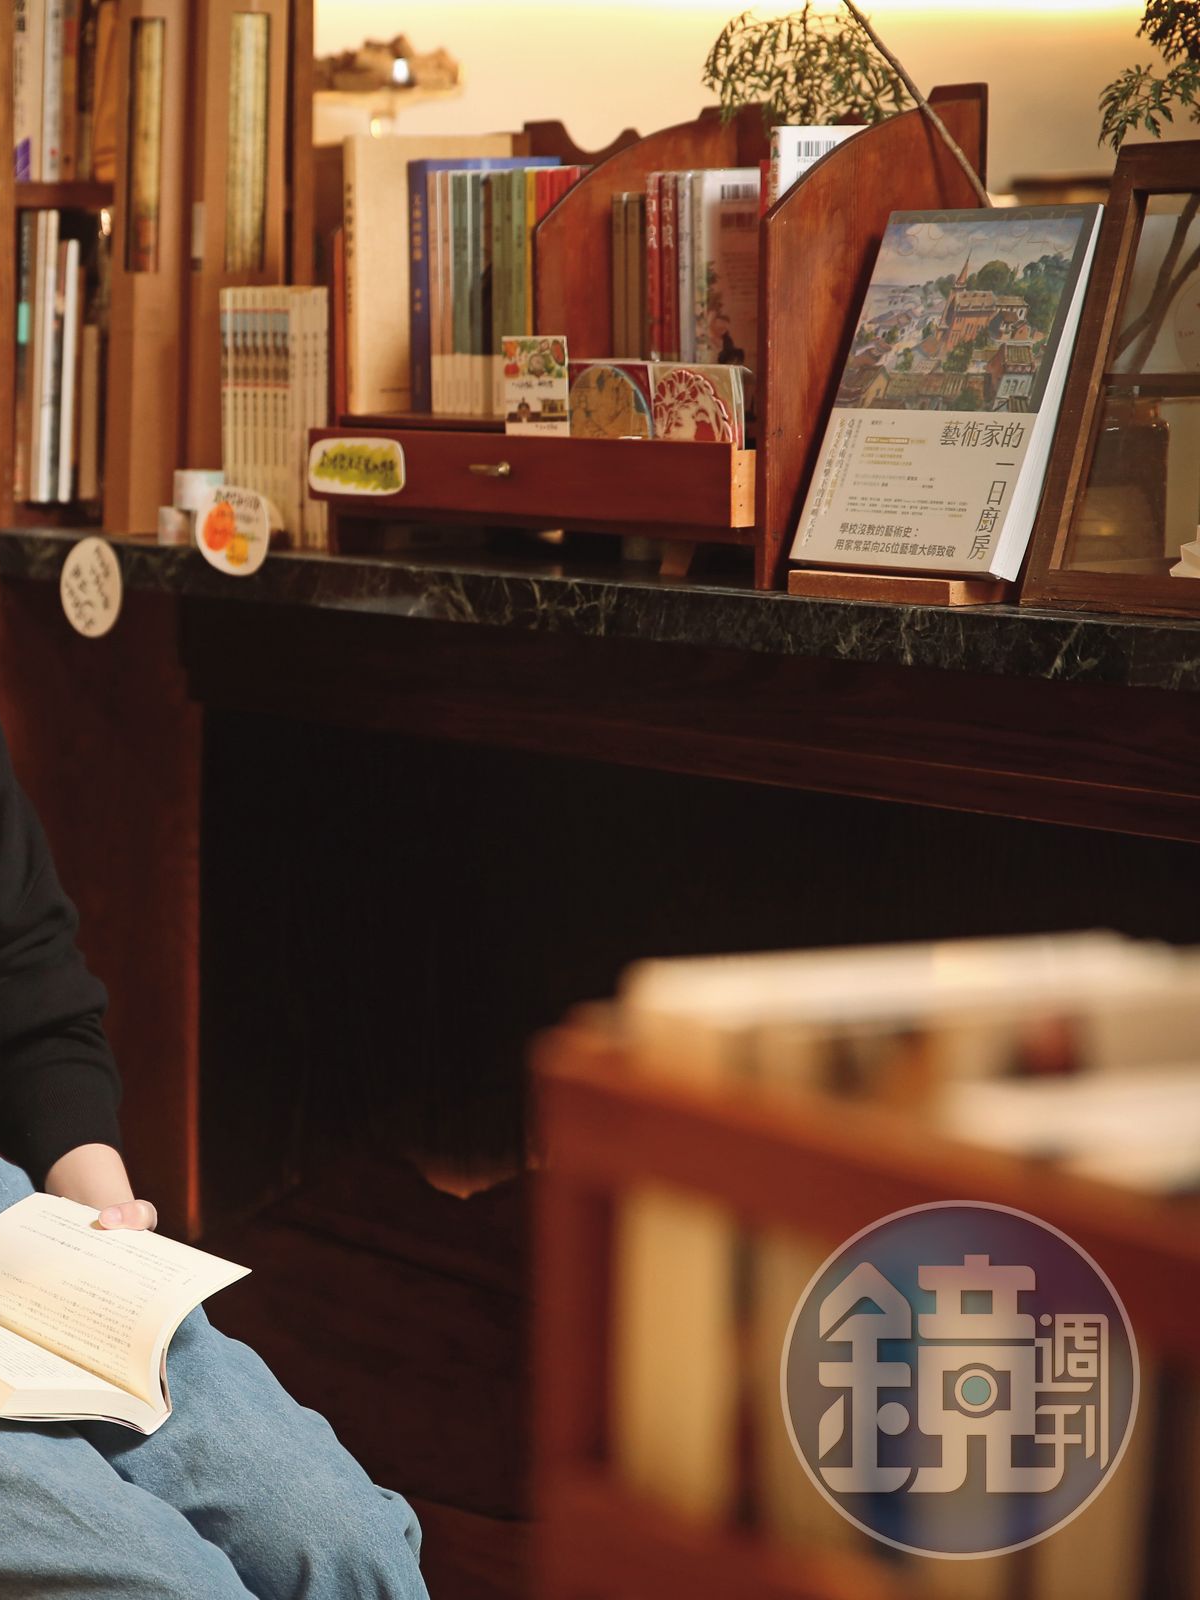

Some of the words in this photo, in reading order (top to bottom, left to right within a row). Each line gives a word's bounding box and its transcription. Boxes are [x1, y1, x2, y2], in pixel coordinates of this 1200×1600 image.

[939, 420, 1026, 449] 藝術家的
[967, 461, 1015, 560] 一日廚房
[839, 522, 920, 539] 學校沒教的藝術史：
[833, 538, 957, 558] 用家常菜向26位藝壇大師致敬
